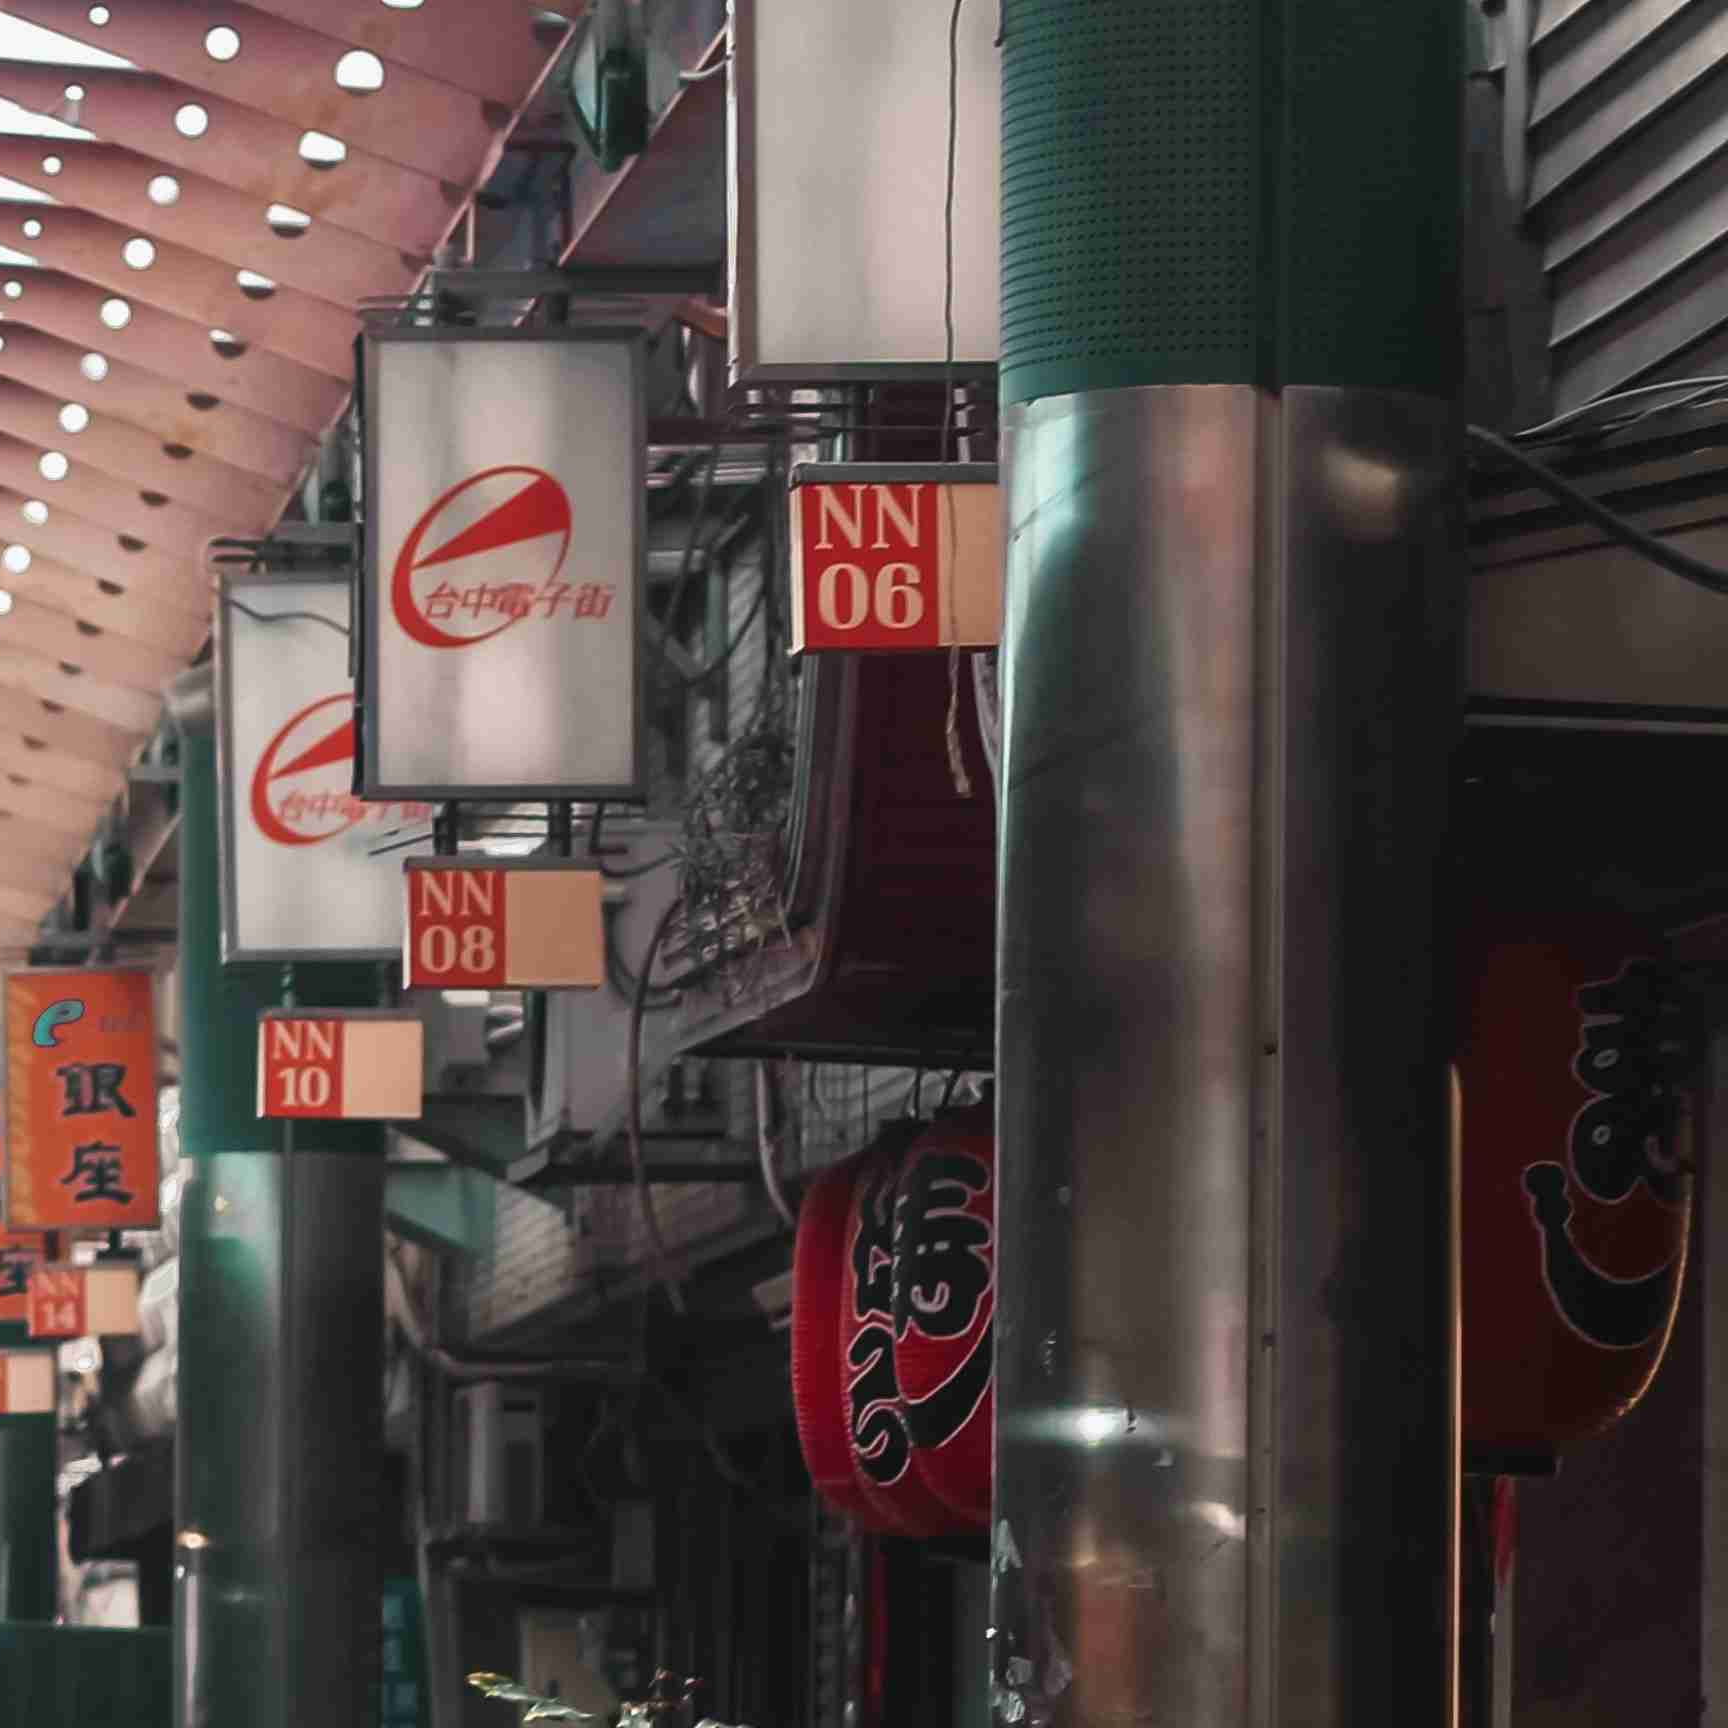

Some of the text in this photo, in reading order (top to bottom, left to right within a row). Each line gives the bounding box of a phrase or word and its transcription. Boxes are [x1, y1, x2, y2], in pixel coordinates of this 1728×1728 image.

[816, 486, 922, 551] NN
[424, 582, 615, 620] 台中電子街
[818, 561, 923, 631] 06
[418, 872, 496, 918] NN
[419, 925, 496, 974] 08
[273, 1023, 336, 1062] NN
[280, 1067, 331, 1108] 10
[56, 1064, 136, 1206] 銀座
